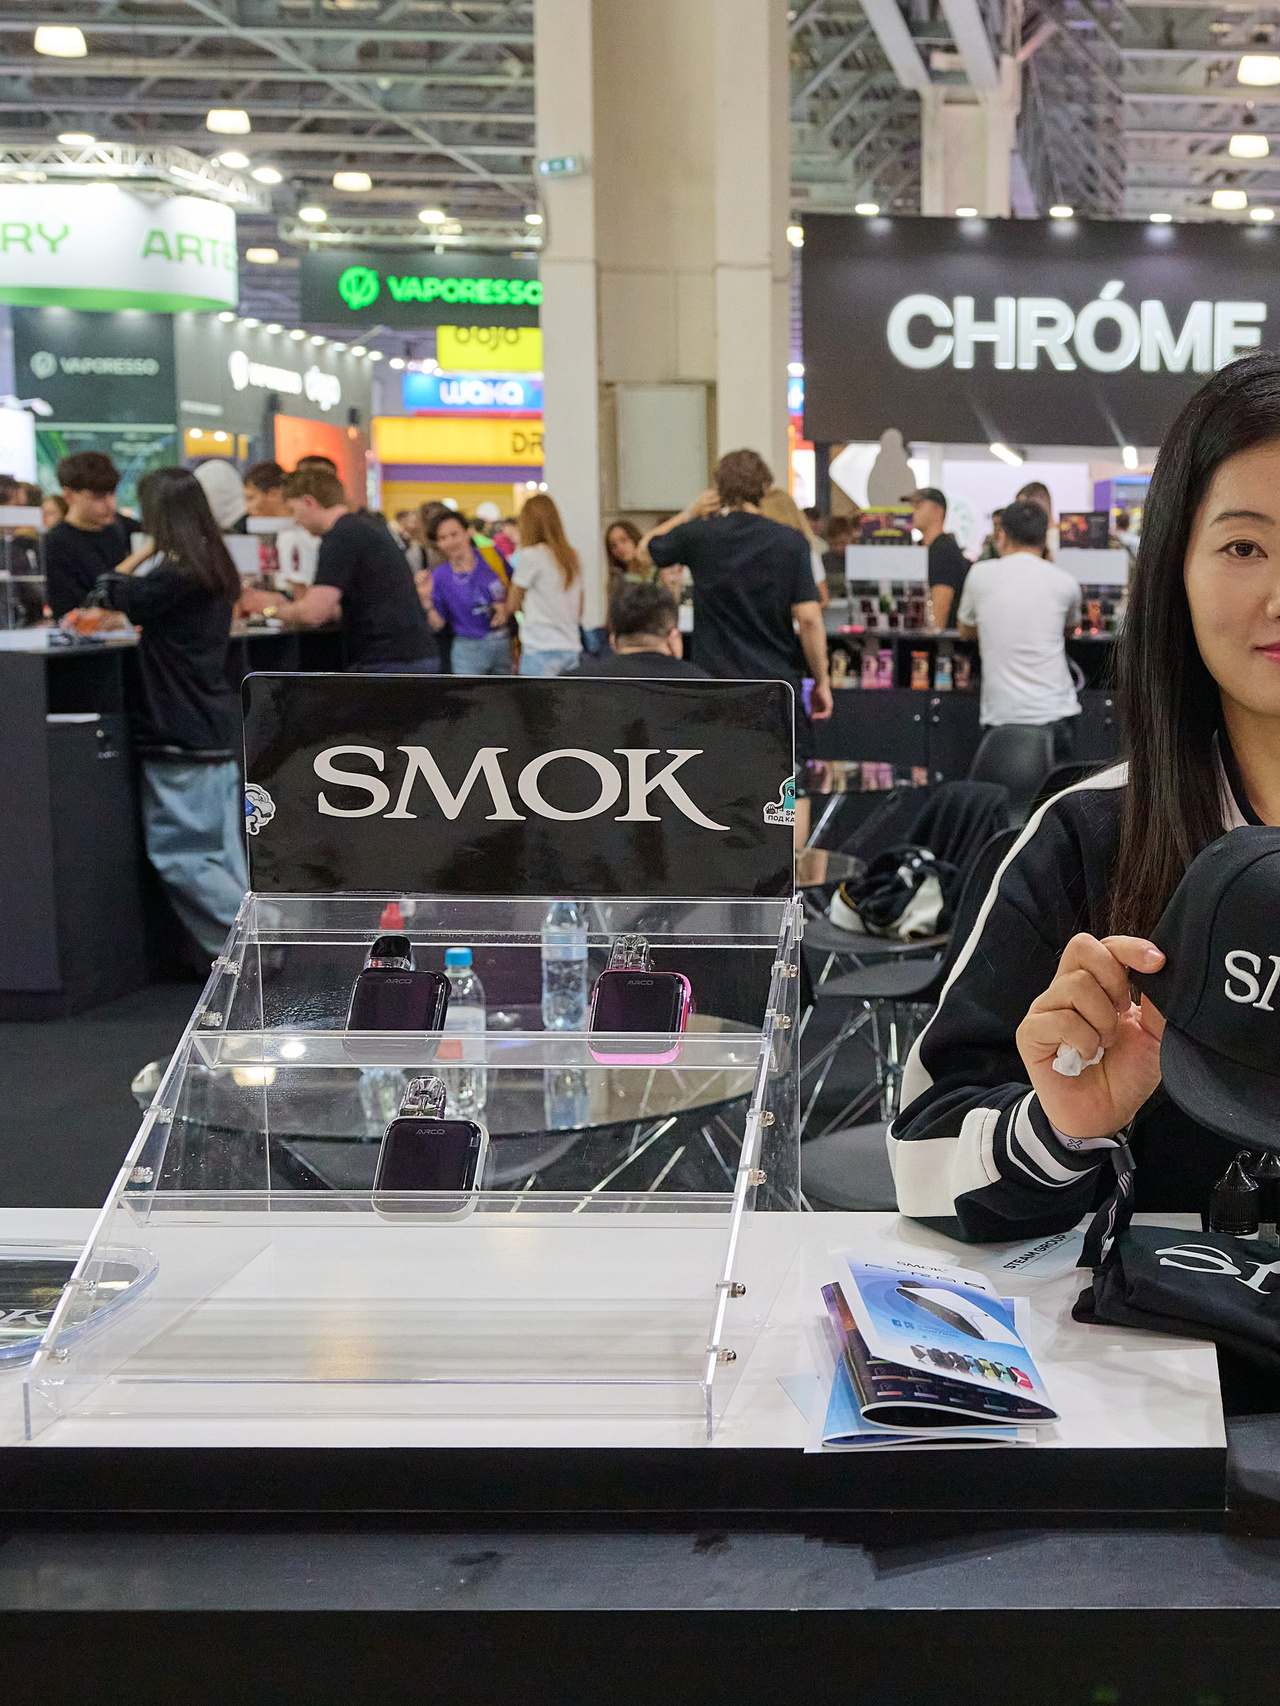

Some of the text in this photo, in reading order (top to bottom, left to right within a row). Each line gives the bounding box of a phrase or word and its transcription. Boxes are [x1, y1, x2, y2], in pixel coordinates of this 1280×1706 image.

[386, 275, 544, 306] VAPORESSO
[313, 745, 731, 831] SMOK
[1003, 1251, 1040, 1270] STEAM
[1033, 1234, 1067, 1252] GROUP
